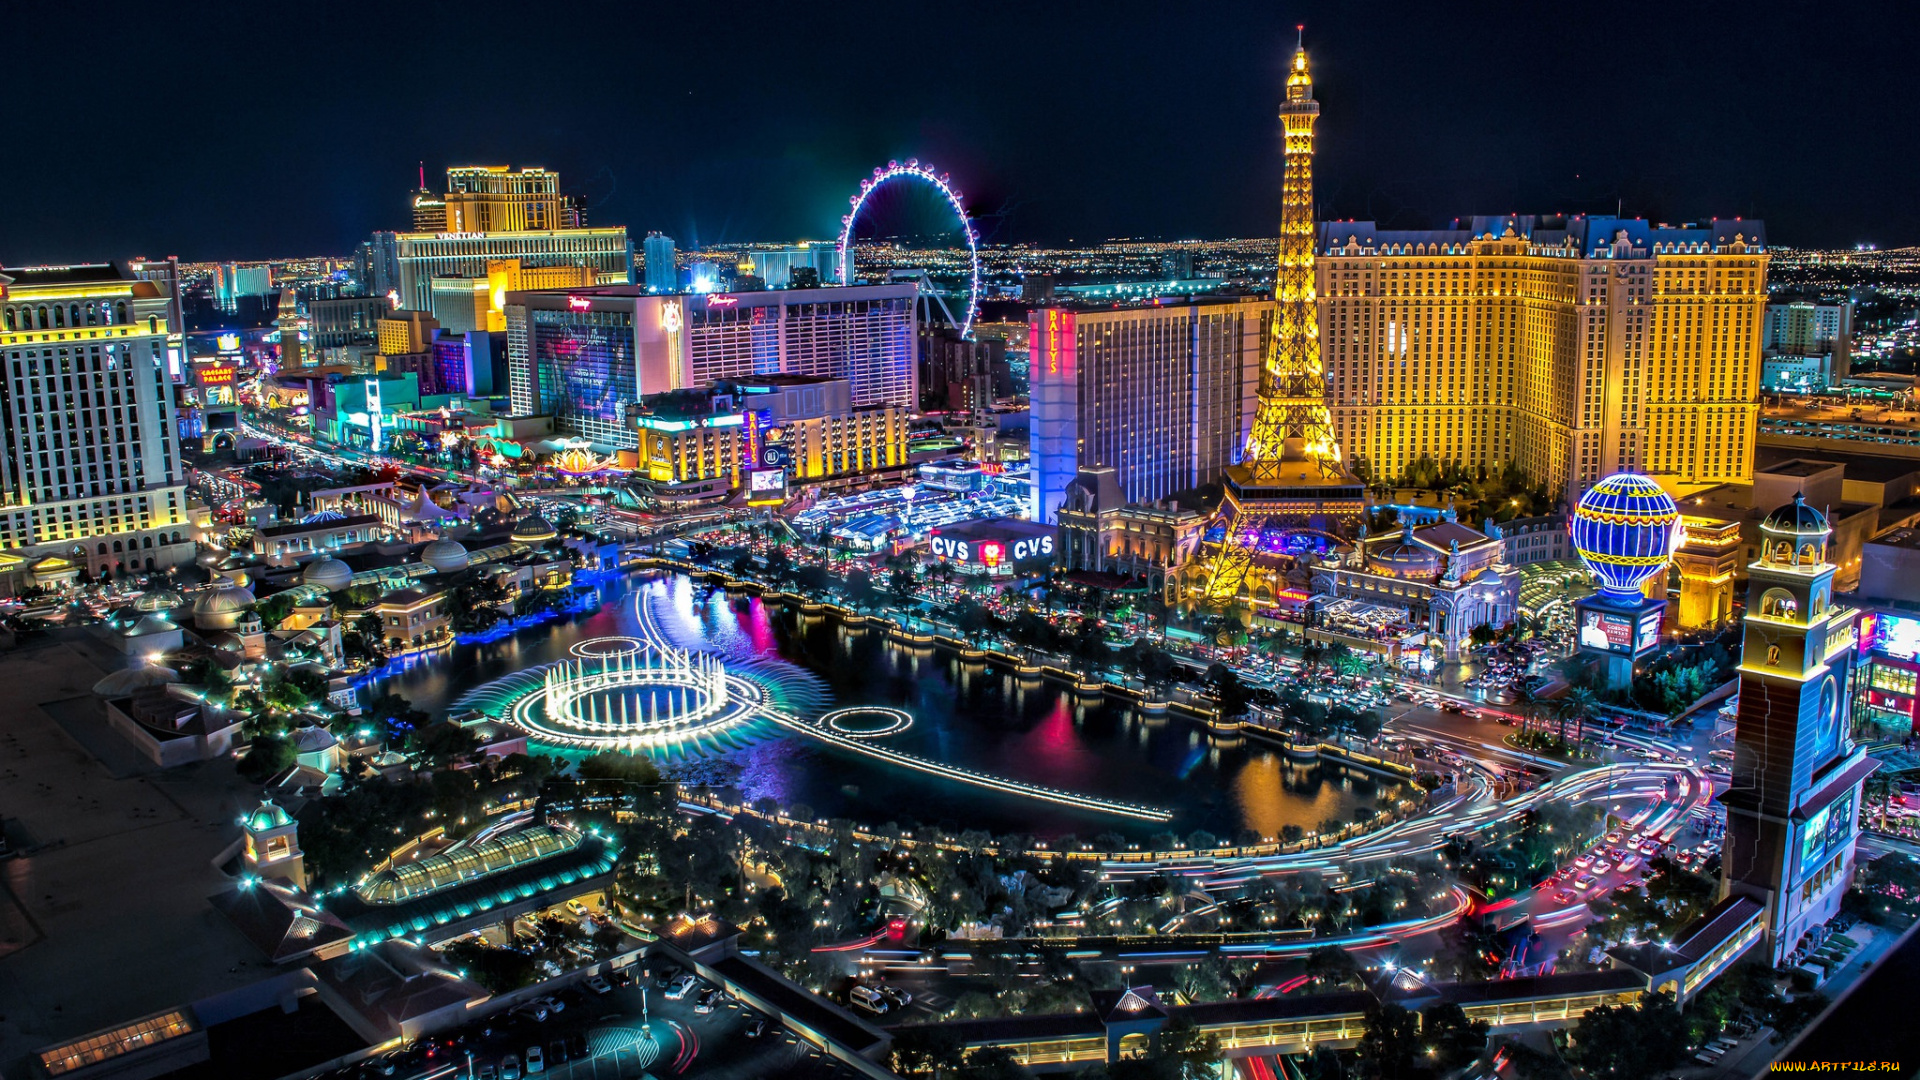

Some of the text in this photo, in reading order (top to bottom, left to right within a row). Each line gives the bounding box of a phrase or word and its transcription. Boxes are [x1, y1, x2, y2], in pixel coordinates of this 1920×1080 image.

[437, 232, 485, 240] VENETIAN
[706, 293, 738, 307] Flamingo
[201, 368, 232, 376] CAESARS
[203, 374, 232, 383] PALACE
[931, 536, 969, 560] CVS
[1014, 535, 1053, 560] CVS
[1607, 624, 1629, 632] GORDON
[1606, 629, 1628, 637] RAMSAY
[1885, 698, 1895, 707] M
